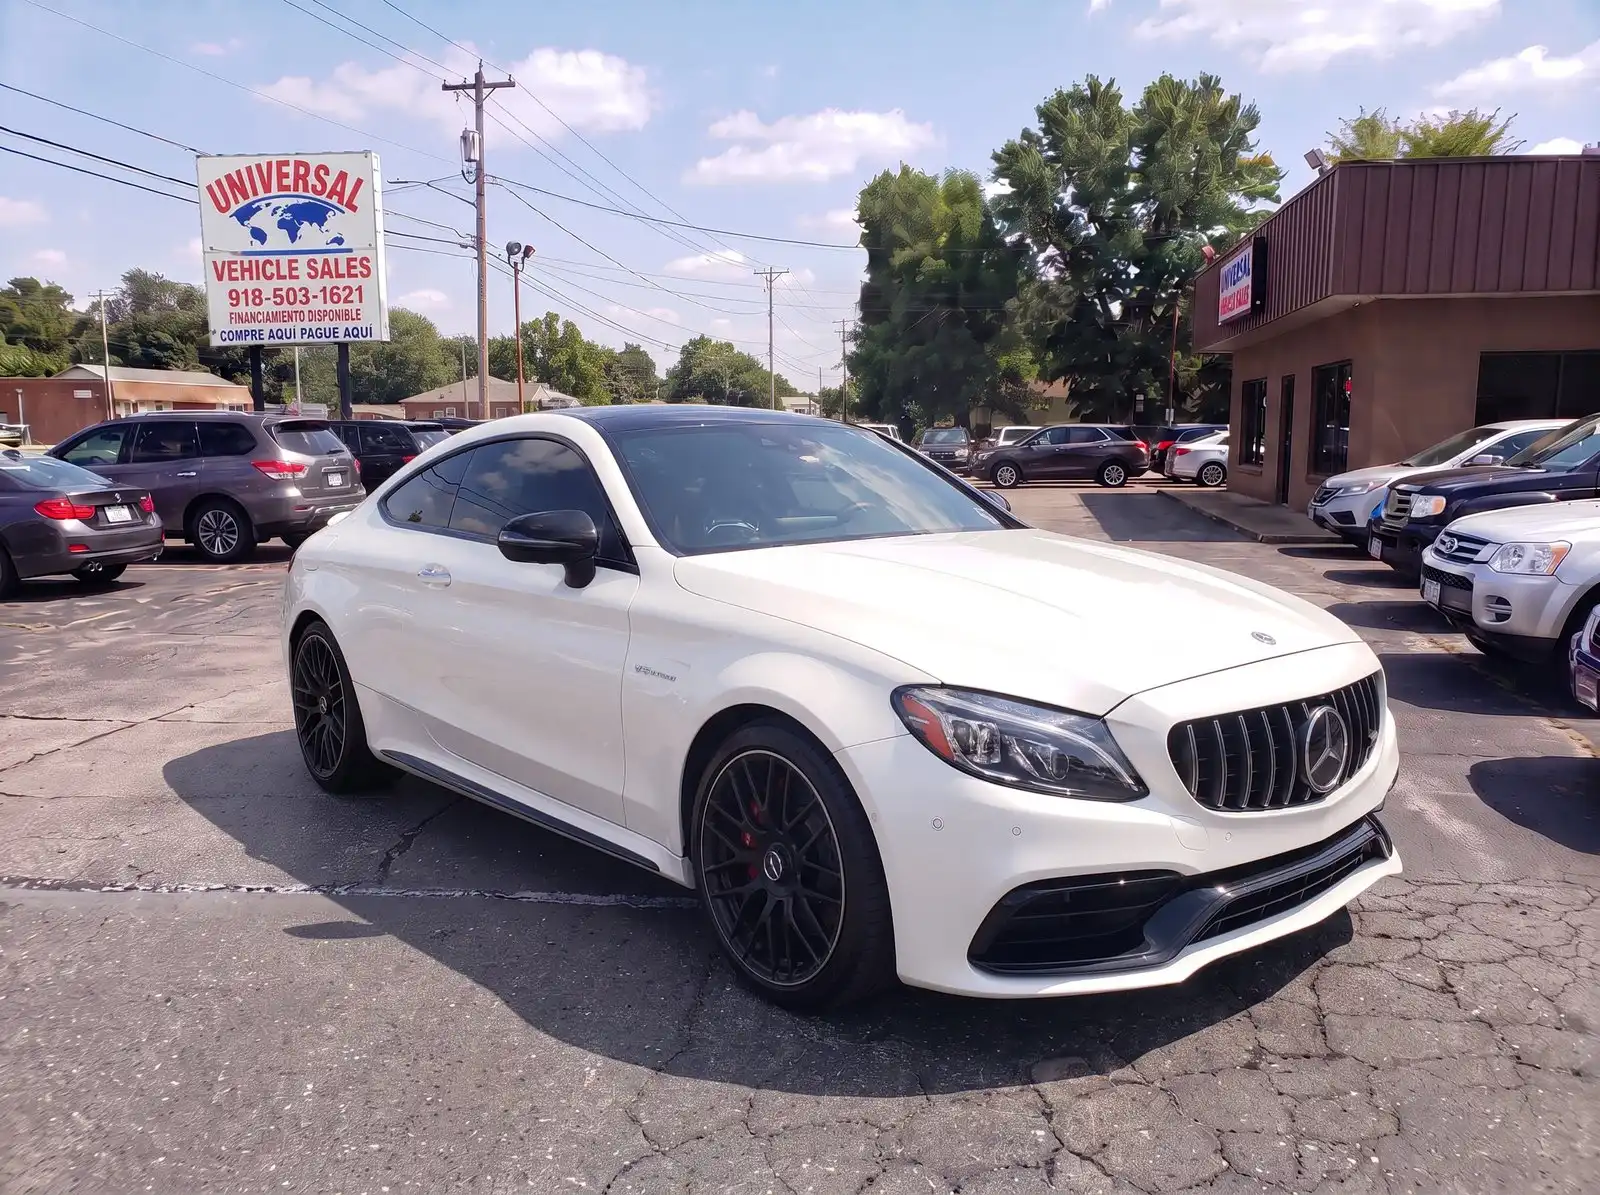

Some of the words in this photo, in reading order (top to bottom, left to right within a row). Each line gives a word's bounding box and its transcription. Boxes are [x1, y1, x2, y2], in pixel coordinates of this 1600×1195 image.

[205, 159, 364, 214] UNIVERSAL
[212, 258, 300, 282] VEHICLE
[306, 256, 372, 280] SALES
[228, 285, 363, 307] 918-503-1621
[229, 309, 305, 325] FINANCIAMIENTO
[308, 308, 362, 322] DISPONIBLE
[220, 328, 265, 342] COMPRE
[300, 326, 339, 340] PAGUE
